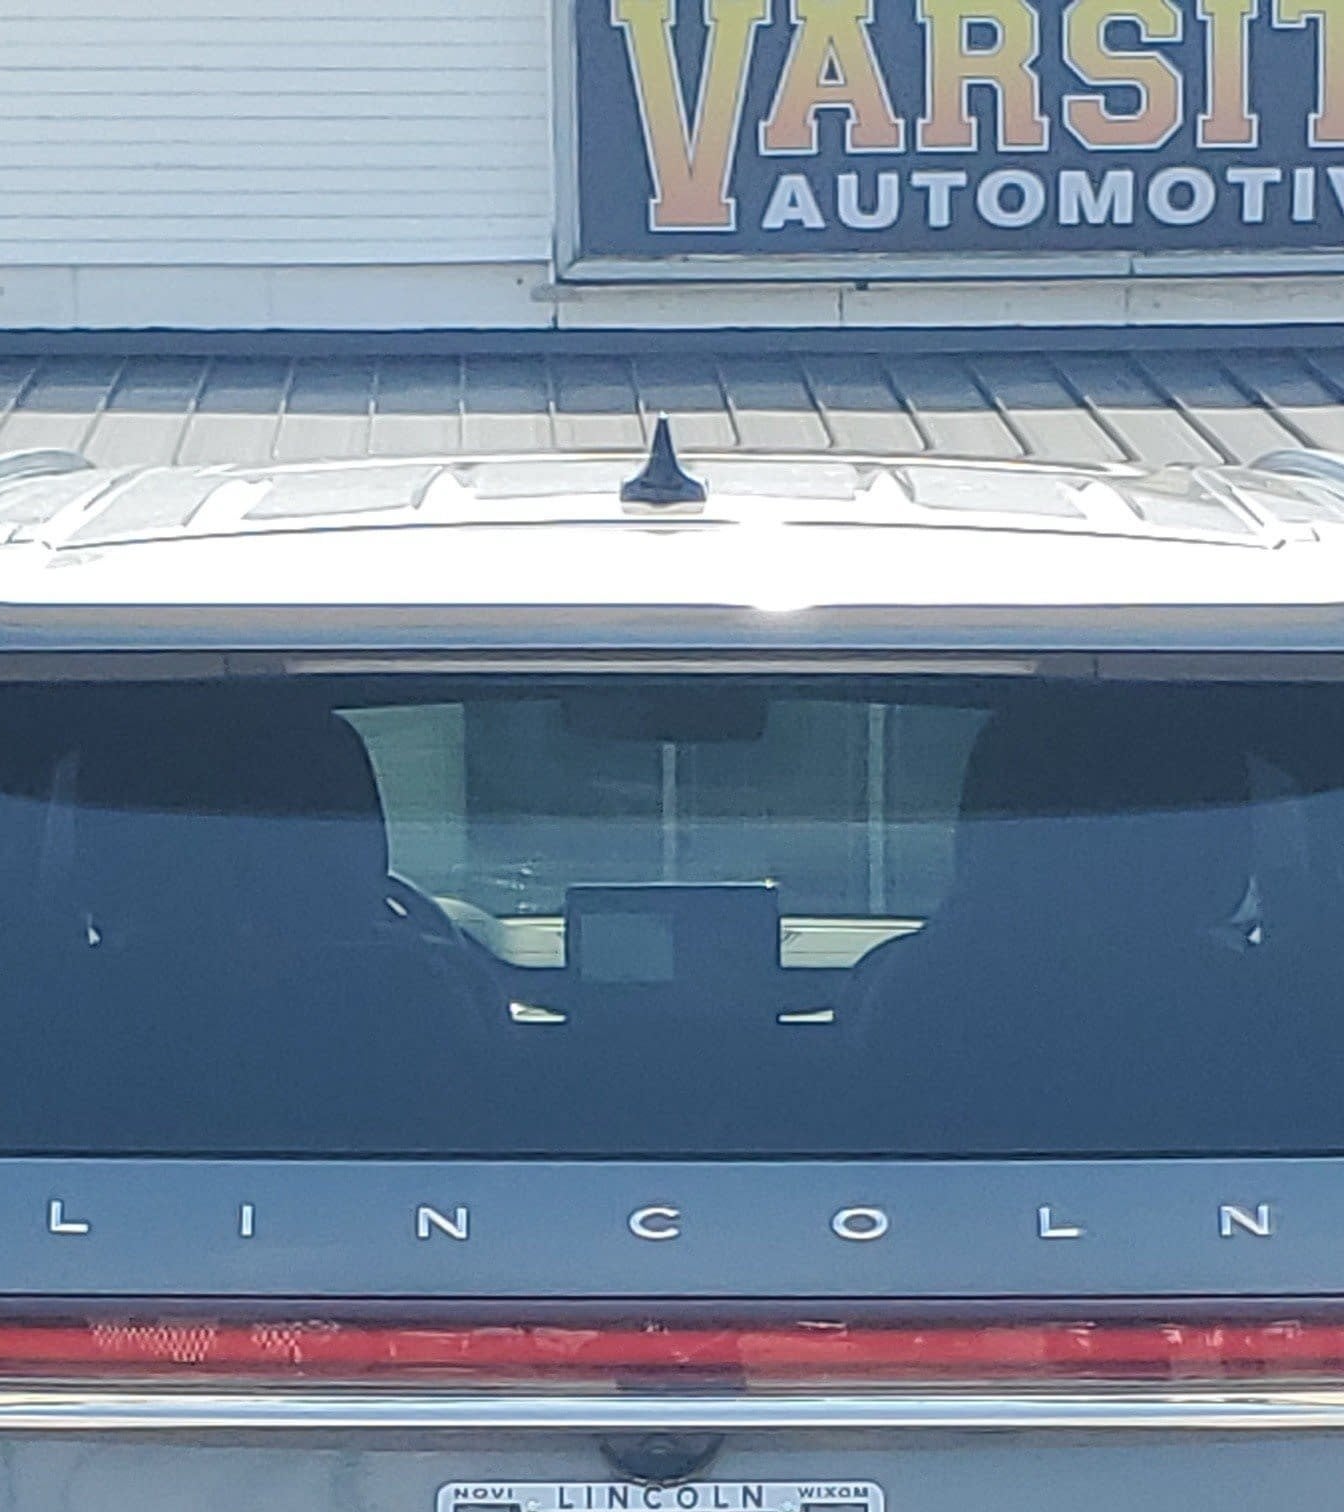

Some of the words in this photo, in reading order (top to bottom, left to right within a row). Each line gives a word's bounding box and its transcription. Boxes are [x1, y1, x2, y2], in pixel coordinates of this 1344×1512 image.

[49, 1198, 1273, 1241] LINCOLN
[453, 1487, 513, 1500] NOVI
[558, 1485, 764, 1510] LINCOLN
[797, 1486, 869, 1499] WIXOM
